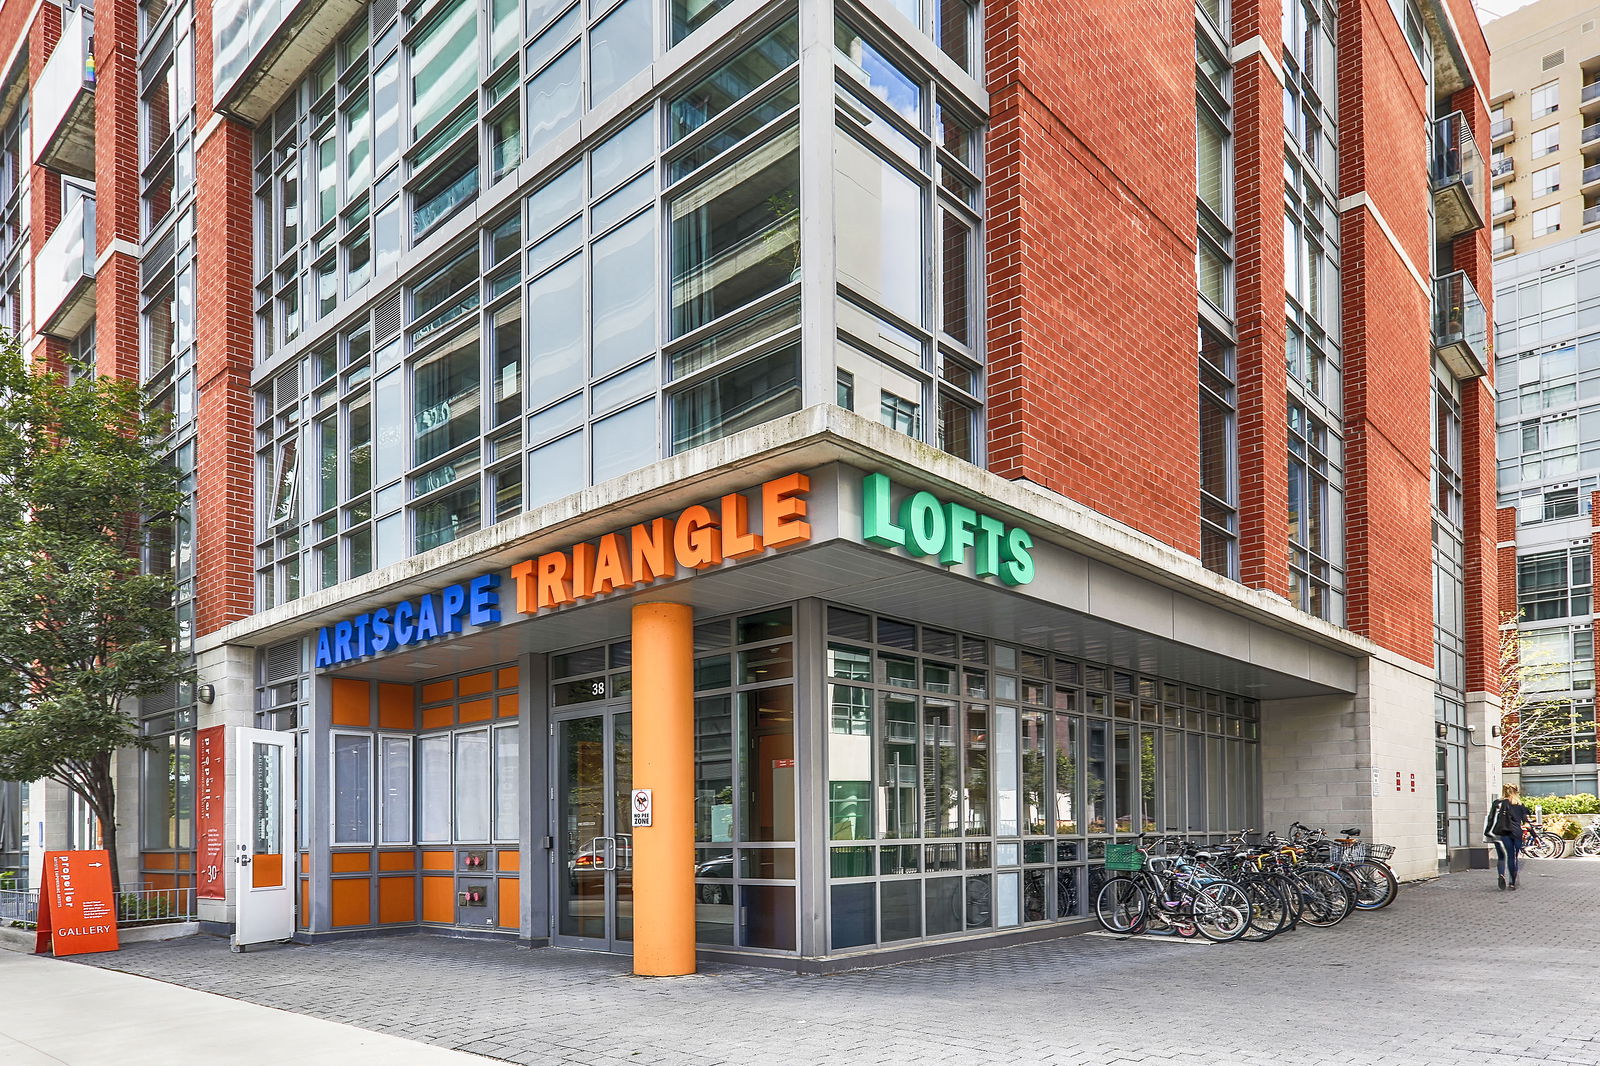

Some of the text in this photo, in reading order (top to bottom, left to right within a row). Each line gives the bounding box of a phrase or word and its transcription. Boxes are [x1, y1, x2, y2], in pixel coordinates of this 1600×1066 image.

[863, 472, 1035, 586] LOFTS
[315, 472, 812, 668] ARTSCAPE TRIANGLE
[592, 682, 605, 696] 38
[59, 856, 75, 907] propeller
[207, 865, 217, 883] 30
[58, 925, 111, 937] GALLERY
